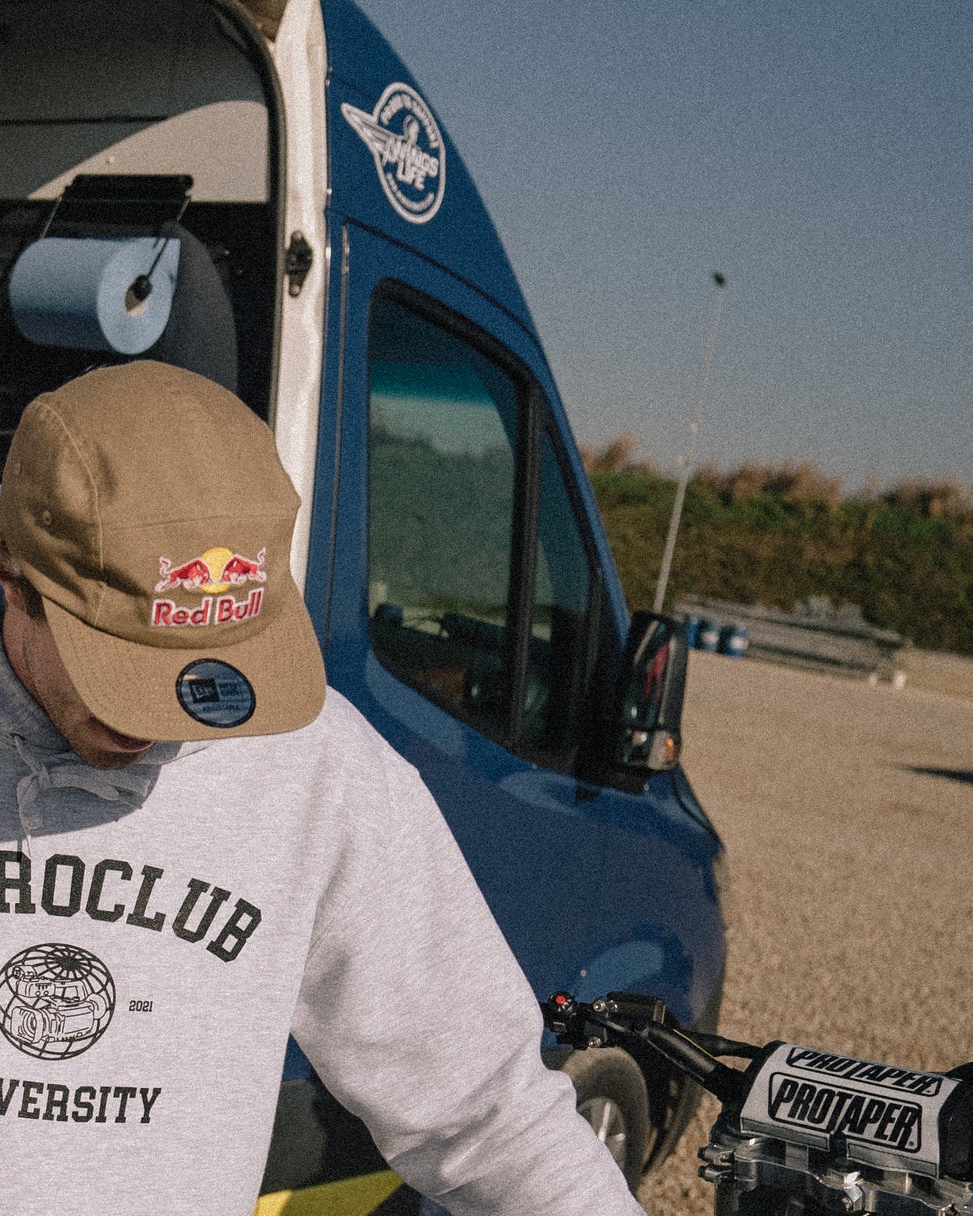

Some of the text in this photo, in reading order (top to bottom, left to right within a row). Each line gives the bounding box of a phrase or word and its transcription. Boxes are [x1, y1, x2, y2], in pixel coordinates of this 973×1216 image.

[152, 587, 264, 627] Red Bull
[128, 999, 153, 1013] 2021
[793, 1048, 939, 1095] PROTAPER
[771, 1078, 917, 1150] PROTAPER
